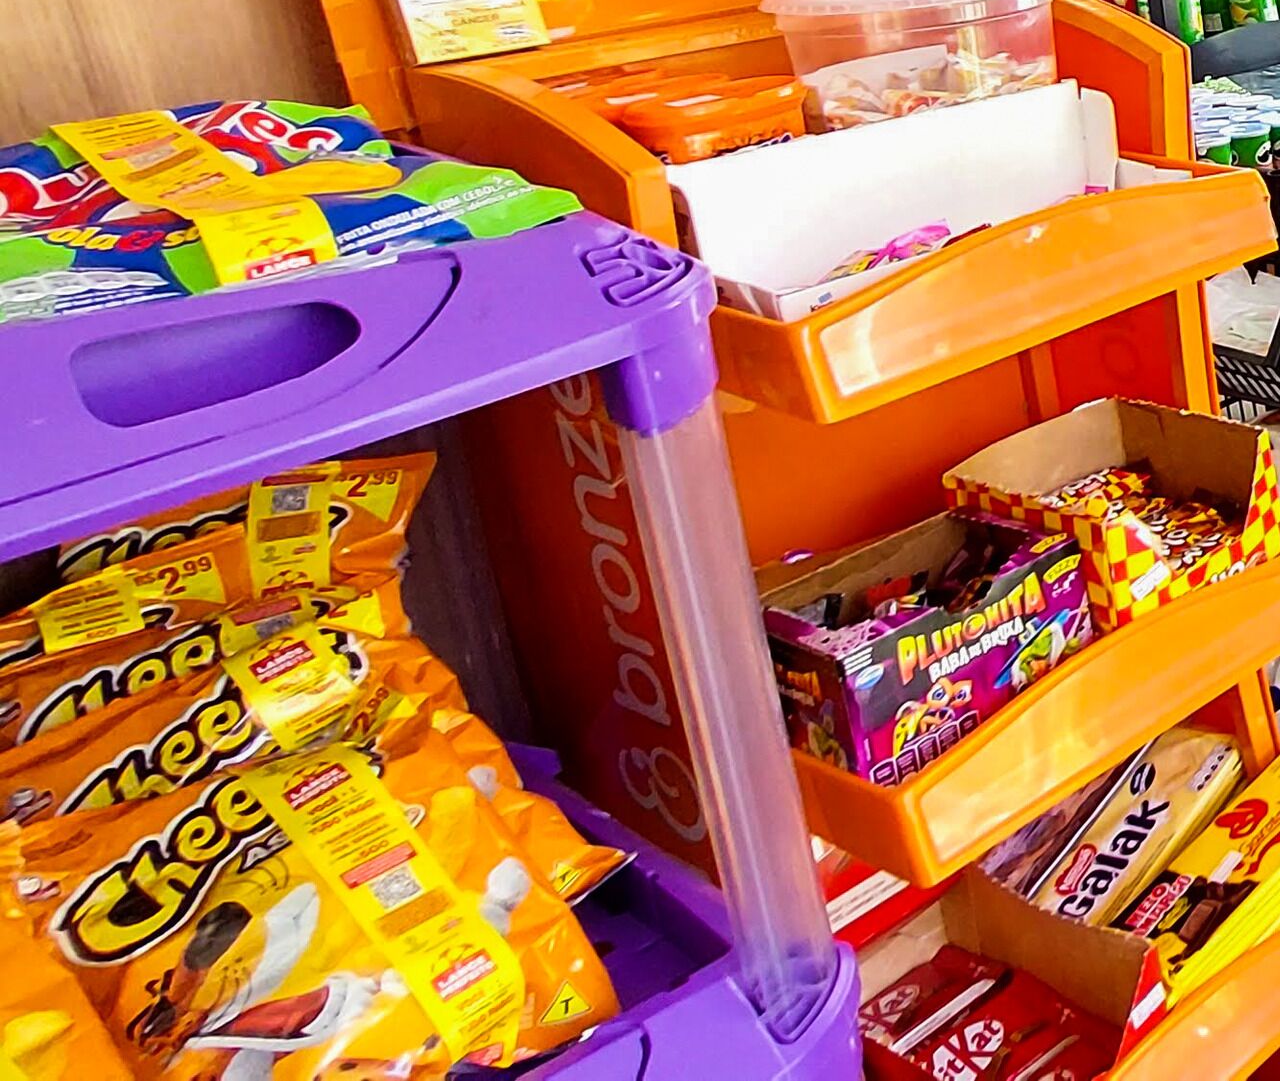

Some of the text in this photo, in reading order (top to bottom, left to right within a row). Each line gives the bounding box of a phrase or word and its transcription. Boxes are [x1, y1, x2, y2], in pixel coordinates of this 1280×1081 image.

[896, 571, 1047, 686] PLUTONITA
[929, 651, 969, 684] BABA
[981, 616, 1025, 655] BRUXA
[1057, 799, 1171, 918] Galak
